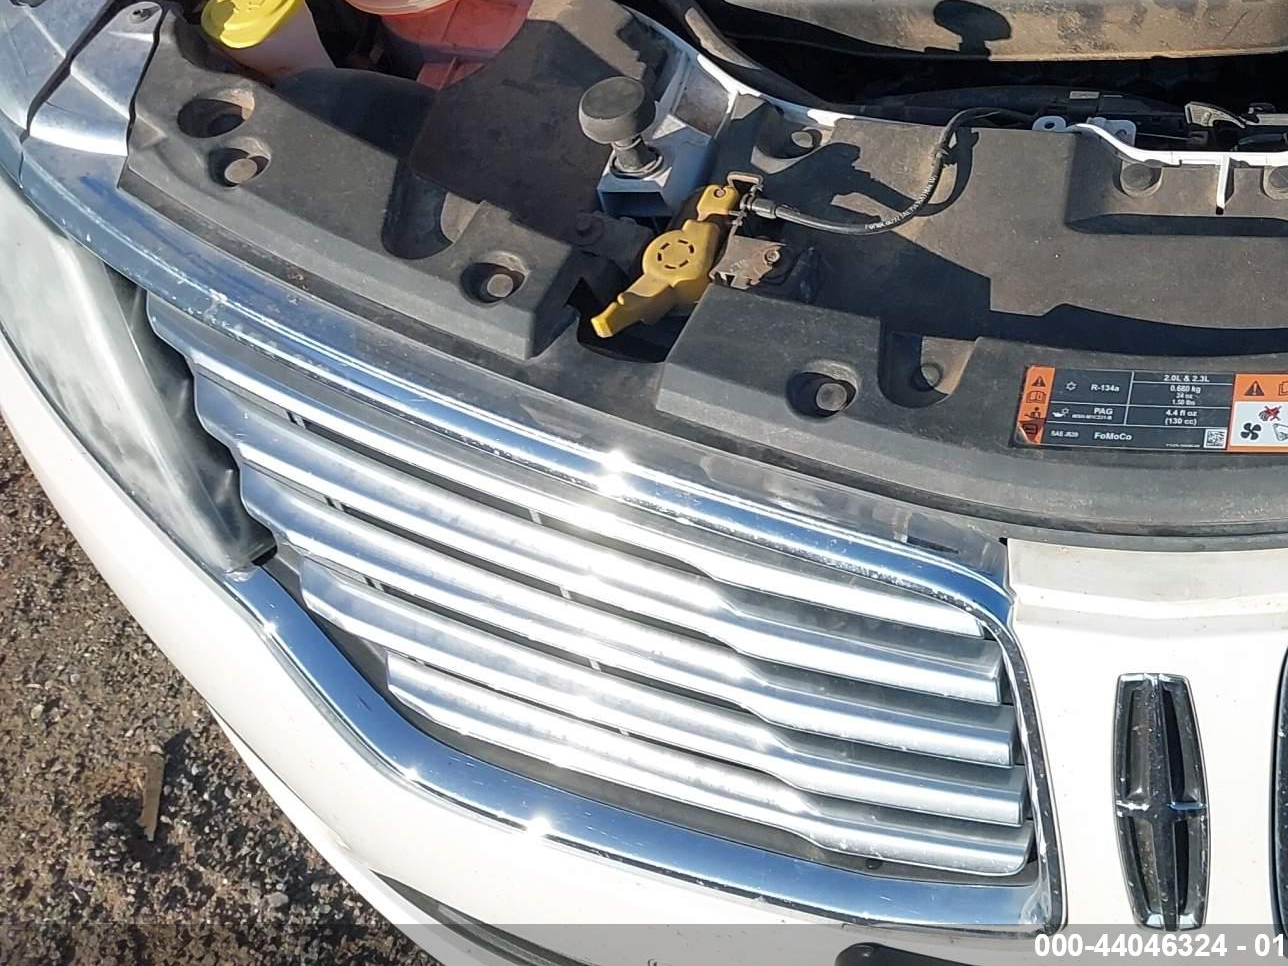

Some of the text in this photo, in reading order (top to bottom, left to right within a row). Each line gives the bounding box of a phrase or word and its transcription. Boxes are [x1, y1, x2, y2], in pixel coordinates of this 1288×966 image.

[1090, 384, 1120, 392] R-134a
[1191, 385, 1201, 394] kg
[1093, 407, 1113, 415] PAG
[1184, 418, 1198, 426] cc)
[1094, 431, 1133, 441] FoMoCo
